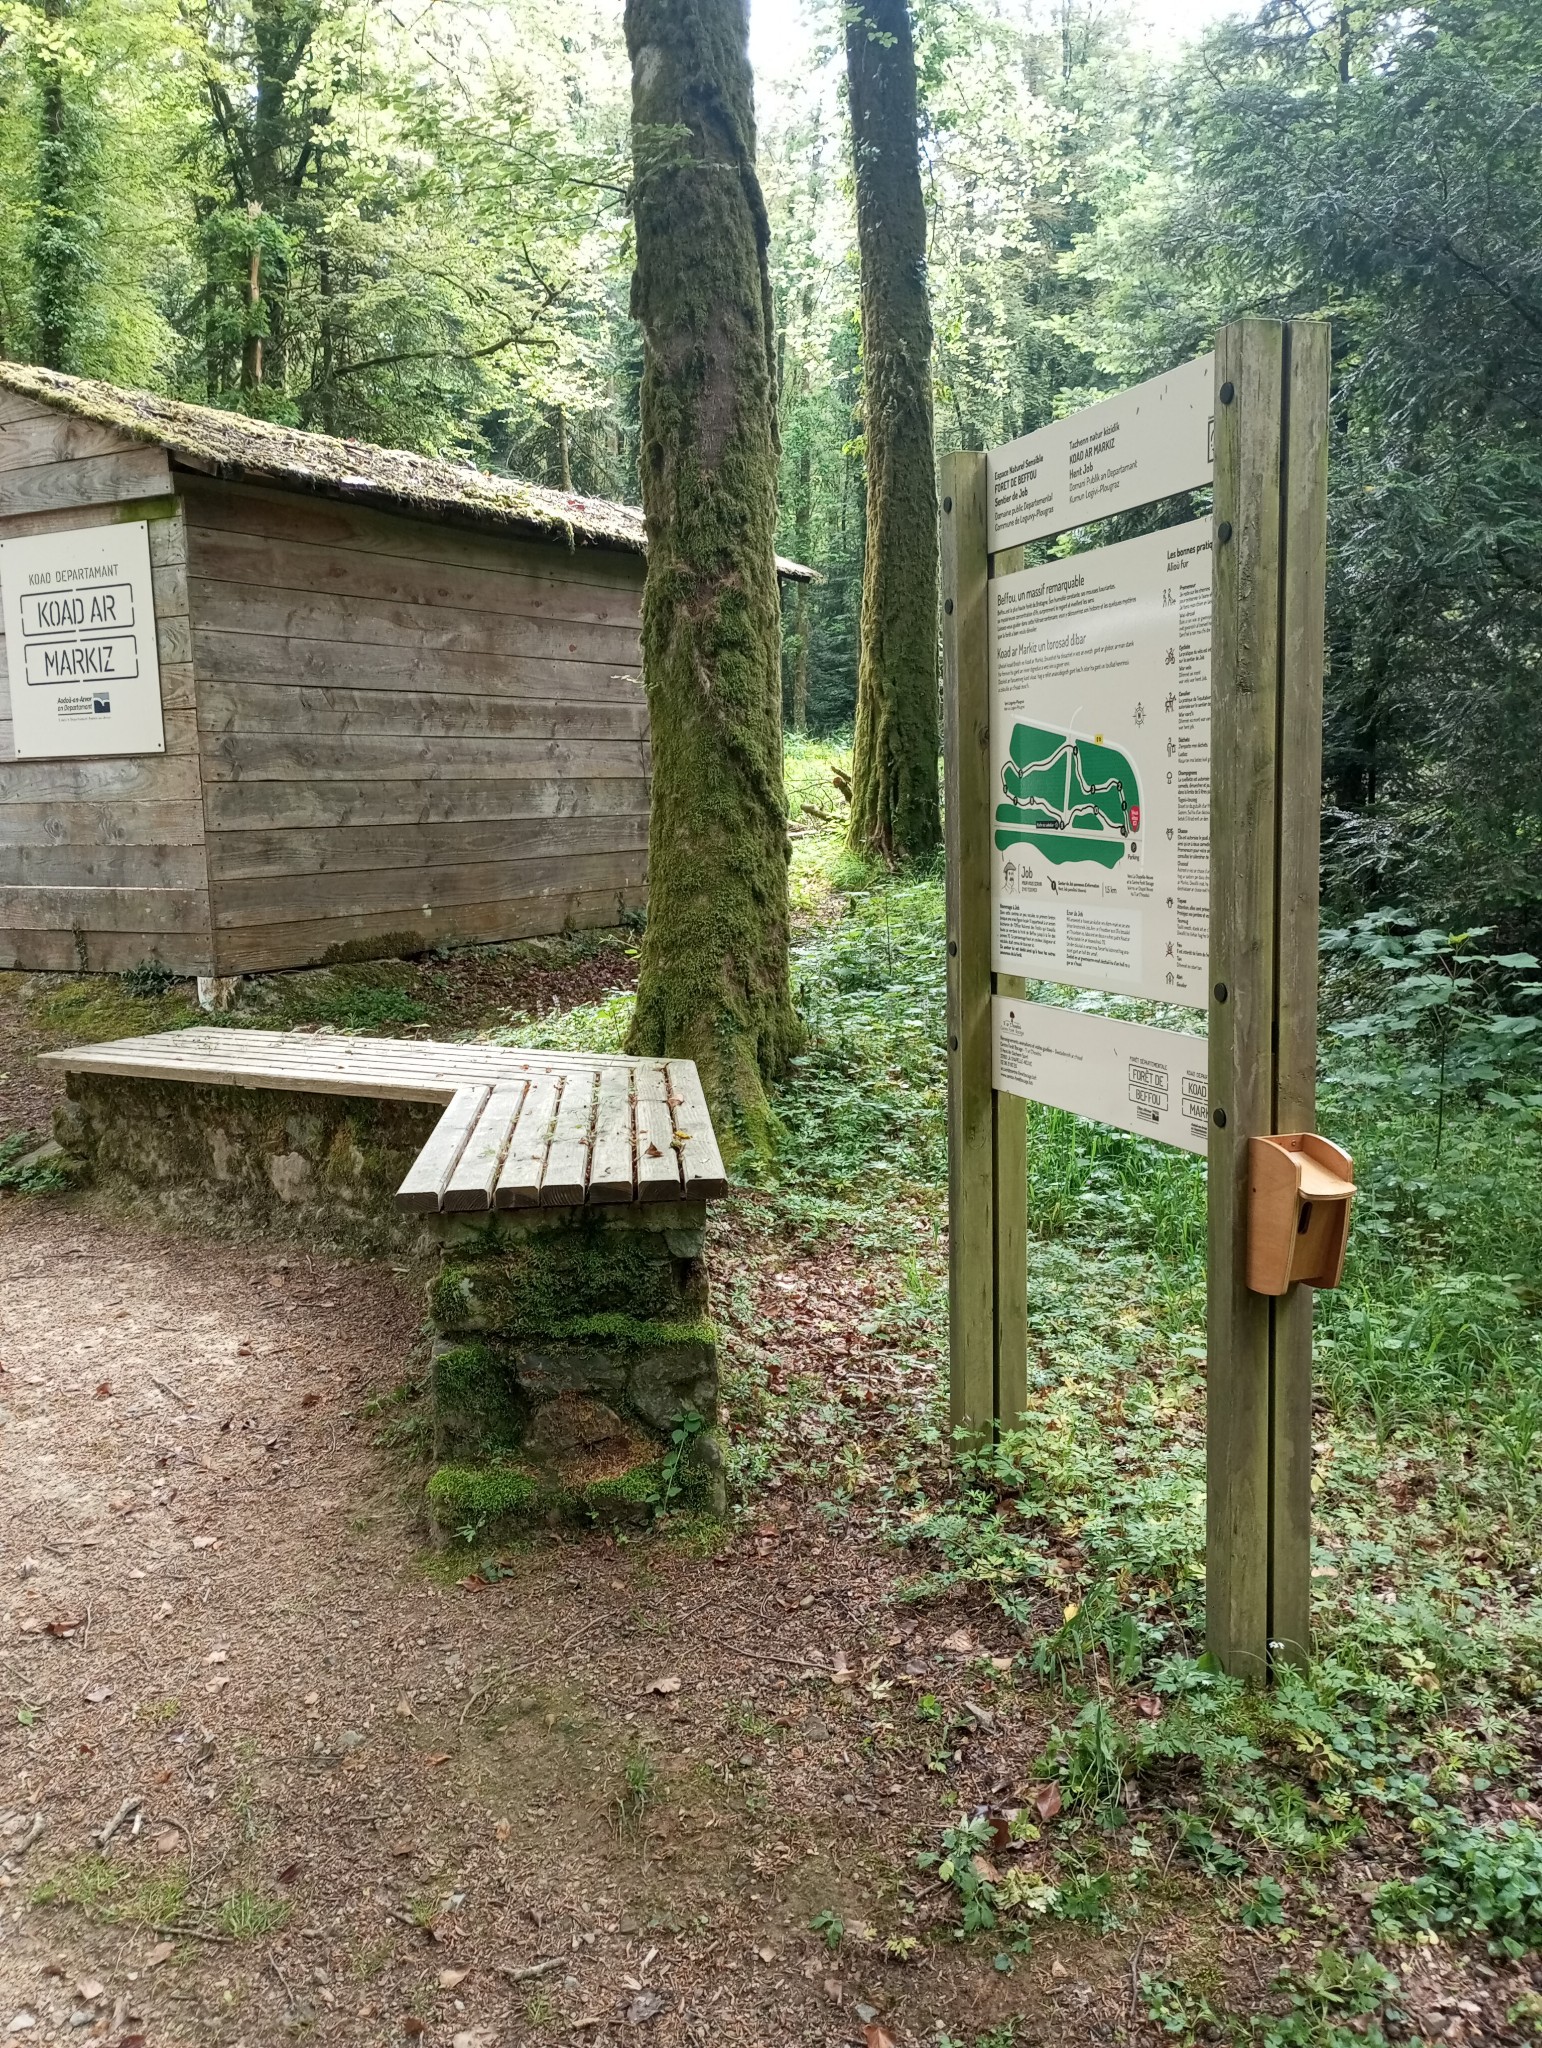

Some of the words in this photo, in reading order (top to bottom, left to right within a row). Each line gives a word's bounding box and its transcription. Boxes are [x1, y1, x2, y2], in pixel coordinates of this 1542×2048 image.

[1085, 447, 1093, 459] AR
[1094, 438, 1115, 455] MARKIZ
[1018, 470, 1037, 485] BEFFOU
[1069, 467, 1082, 479] Hent
[1083, 462, 1093, 474] Job
[995, 495, 1011, 507] Sentier
[1012, 491, 1018, 501] de
[1019, 487, 1028, 498] Job
[1167, 551, 1176, 560] Les
[1177, 547, 1195, 557] bonnes
[56, 564, 119, 582] DEPARTAMANT
[1018, 592, 1025, 601] un
[1026, 583, 1045, 598] massif
[1046, 574, 1084, 594] remarquable
[38, 598, 84, 627] KOAD
[91, 595, 116, 623] AR
[1012, 648, 1018, 657] ar
[44, 646, 115, 677] MARKIZ
[1021, 866, 1033, 878] Job
[1133, 1066, 1153, 1083] FORÊT
[1155, 1071, 1164, 1087] DE
[1136, 1089, 1160, 1105] BEFFOU
[1188, 1083, 1207, 1097] KOAD
